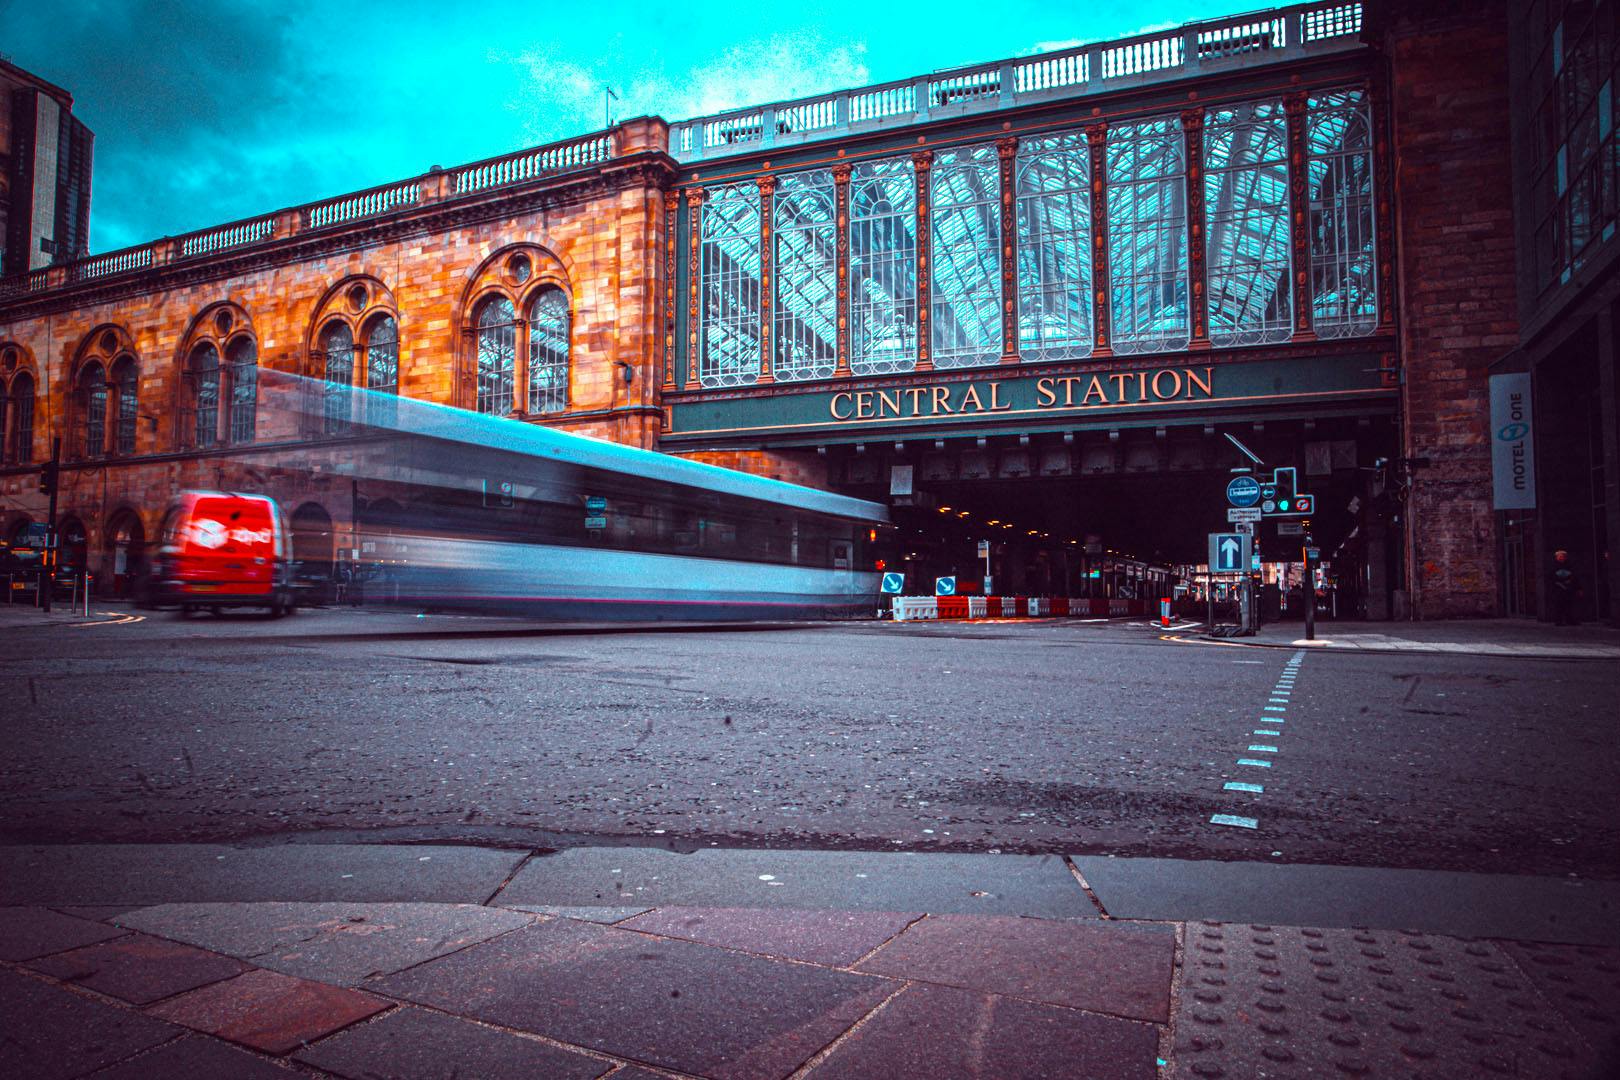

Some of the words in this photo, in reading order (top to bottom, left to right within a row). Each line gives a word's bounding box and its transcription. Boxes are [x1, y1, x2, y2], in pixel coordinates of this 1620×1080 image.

[830, 383, 1012, 420] CENTRAL
[1036, 367, 1213, 407] STATION
[1511, 393, 1522, 420] ONE
[1512, 441, 1525, 490] MOTEL
